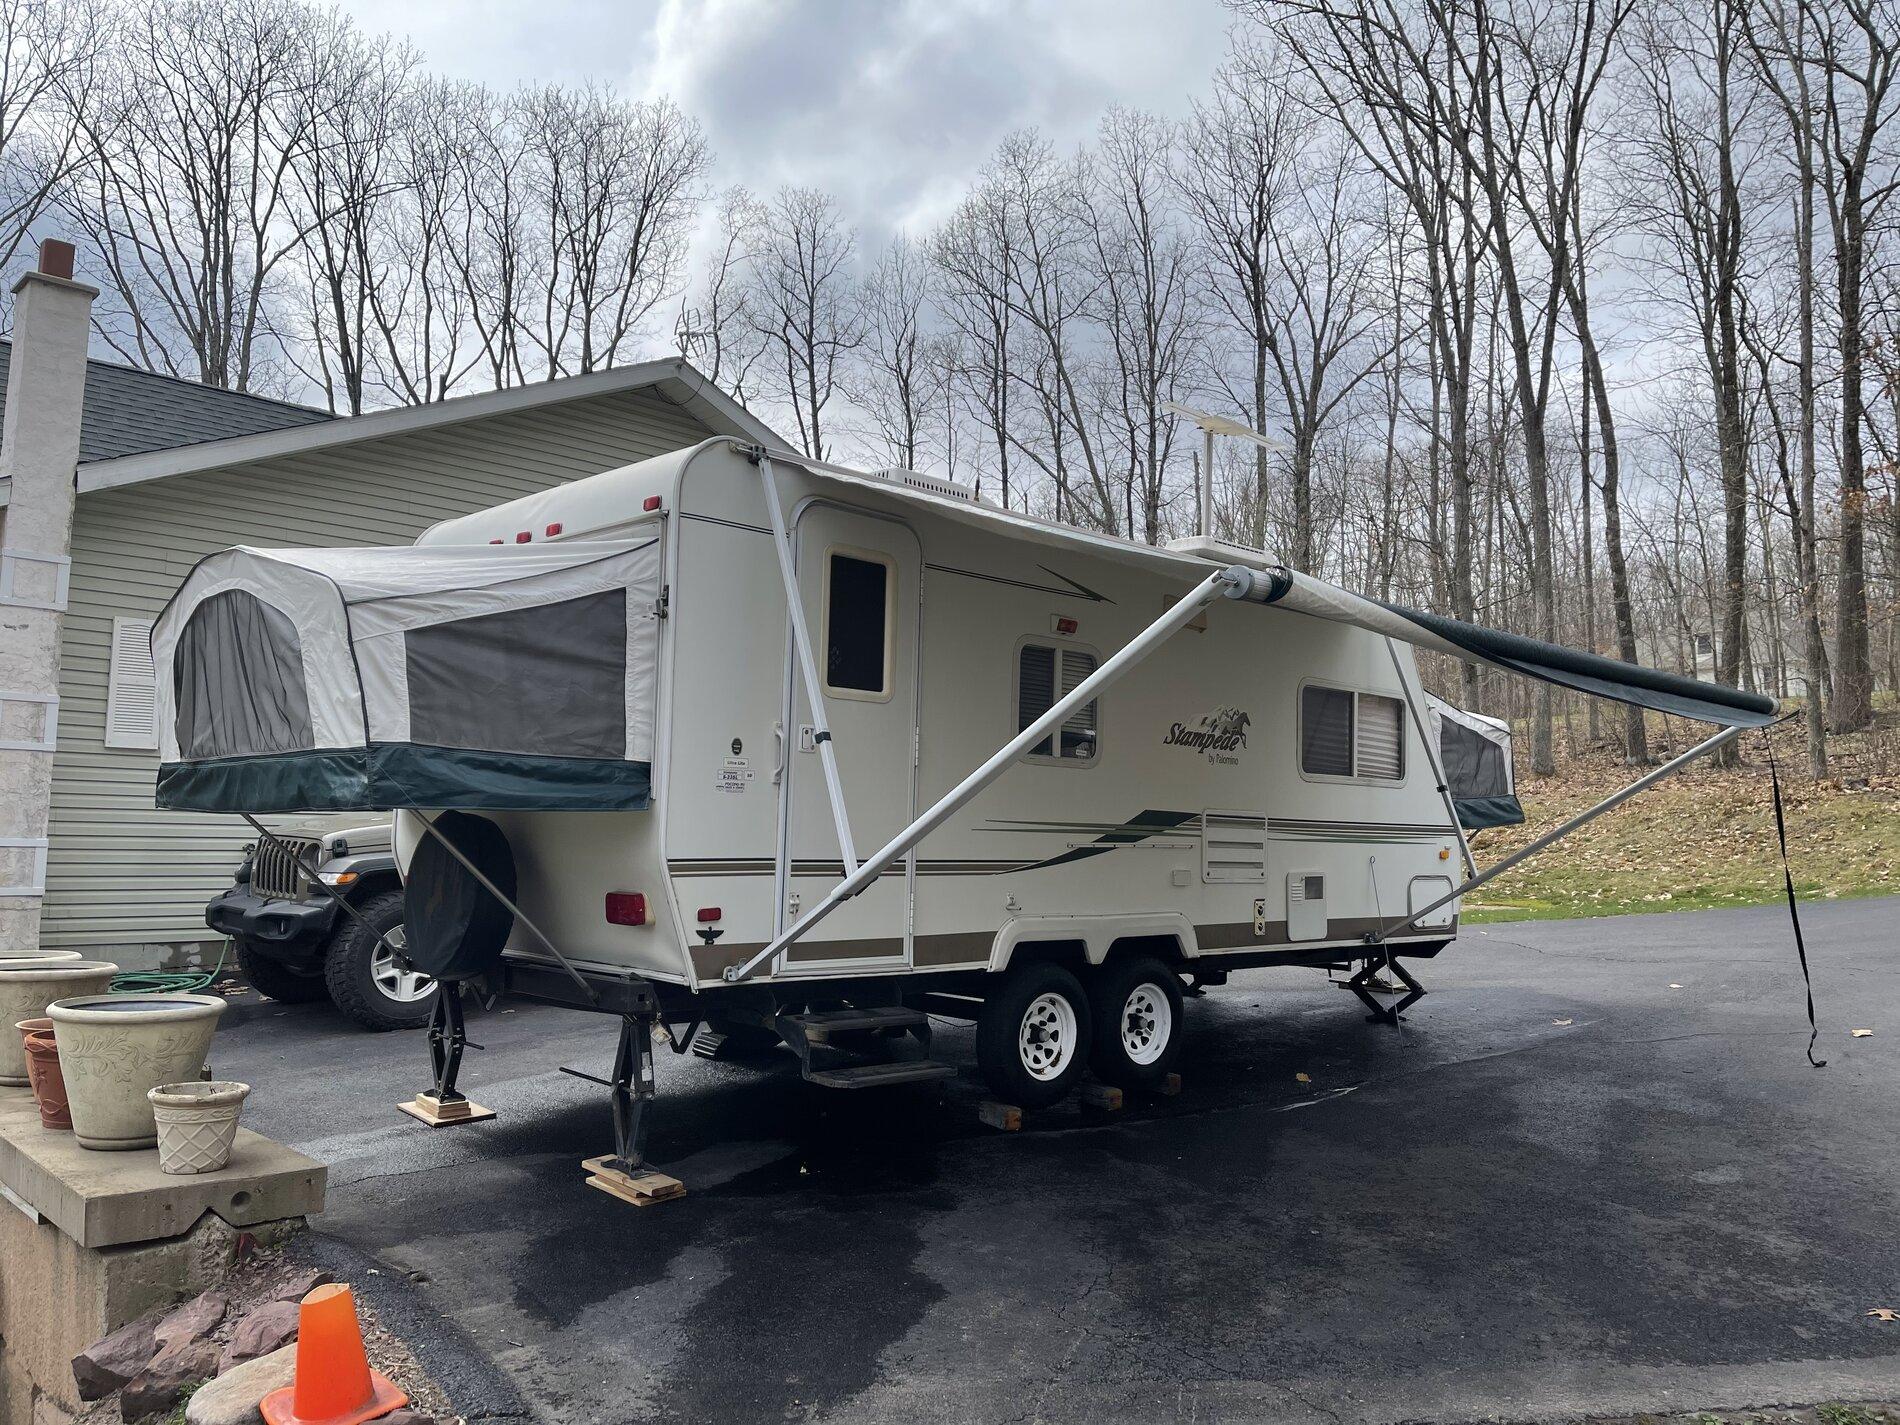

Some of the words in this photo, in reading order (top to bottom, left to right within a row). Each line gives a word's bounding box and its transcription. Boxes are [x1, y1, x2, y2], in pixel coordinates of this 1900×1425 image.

[1163, 722, 1240, 753] Stampede
[1208, 753, 1215, 765] by
[1216, 754, 1239, 765] Palomino
